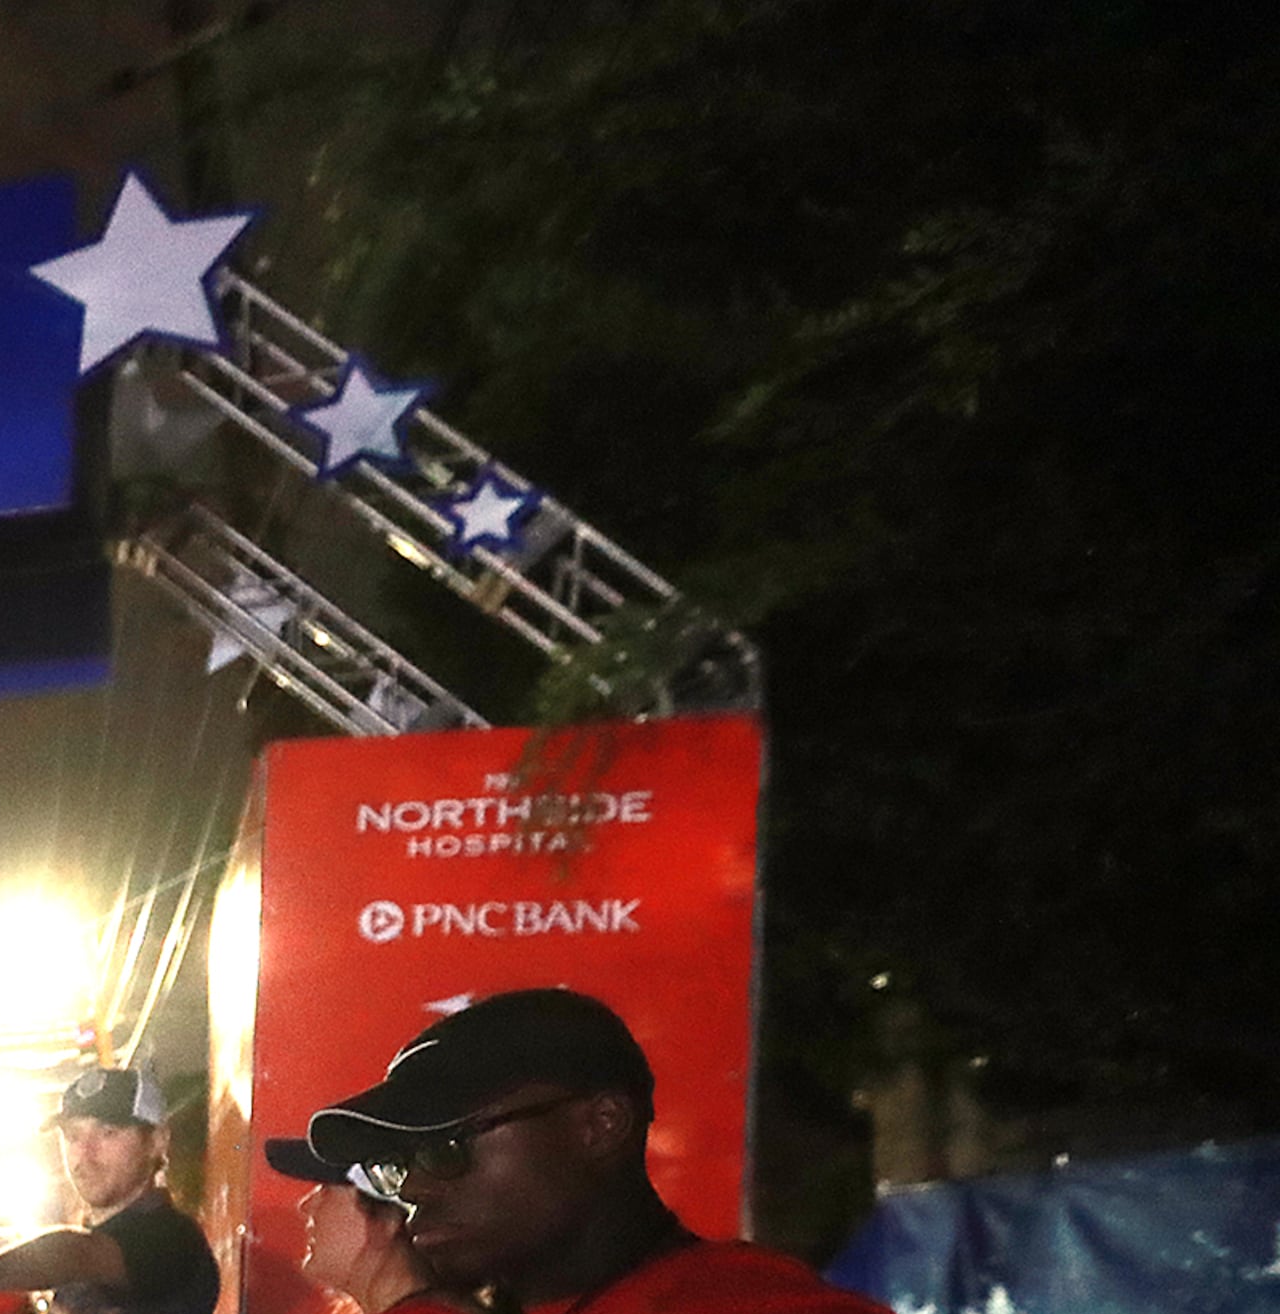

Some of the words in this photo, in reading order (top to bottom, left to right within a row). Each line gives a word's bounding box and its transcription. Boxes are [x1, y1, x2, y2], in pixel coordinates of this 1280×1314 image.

[405, 831, 590, 859] HOSPITA
[412, 901, 508, 938] PNC
[513, 898, 641, 937] BANK
